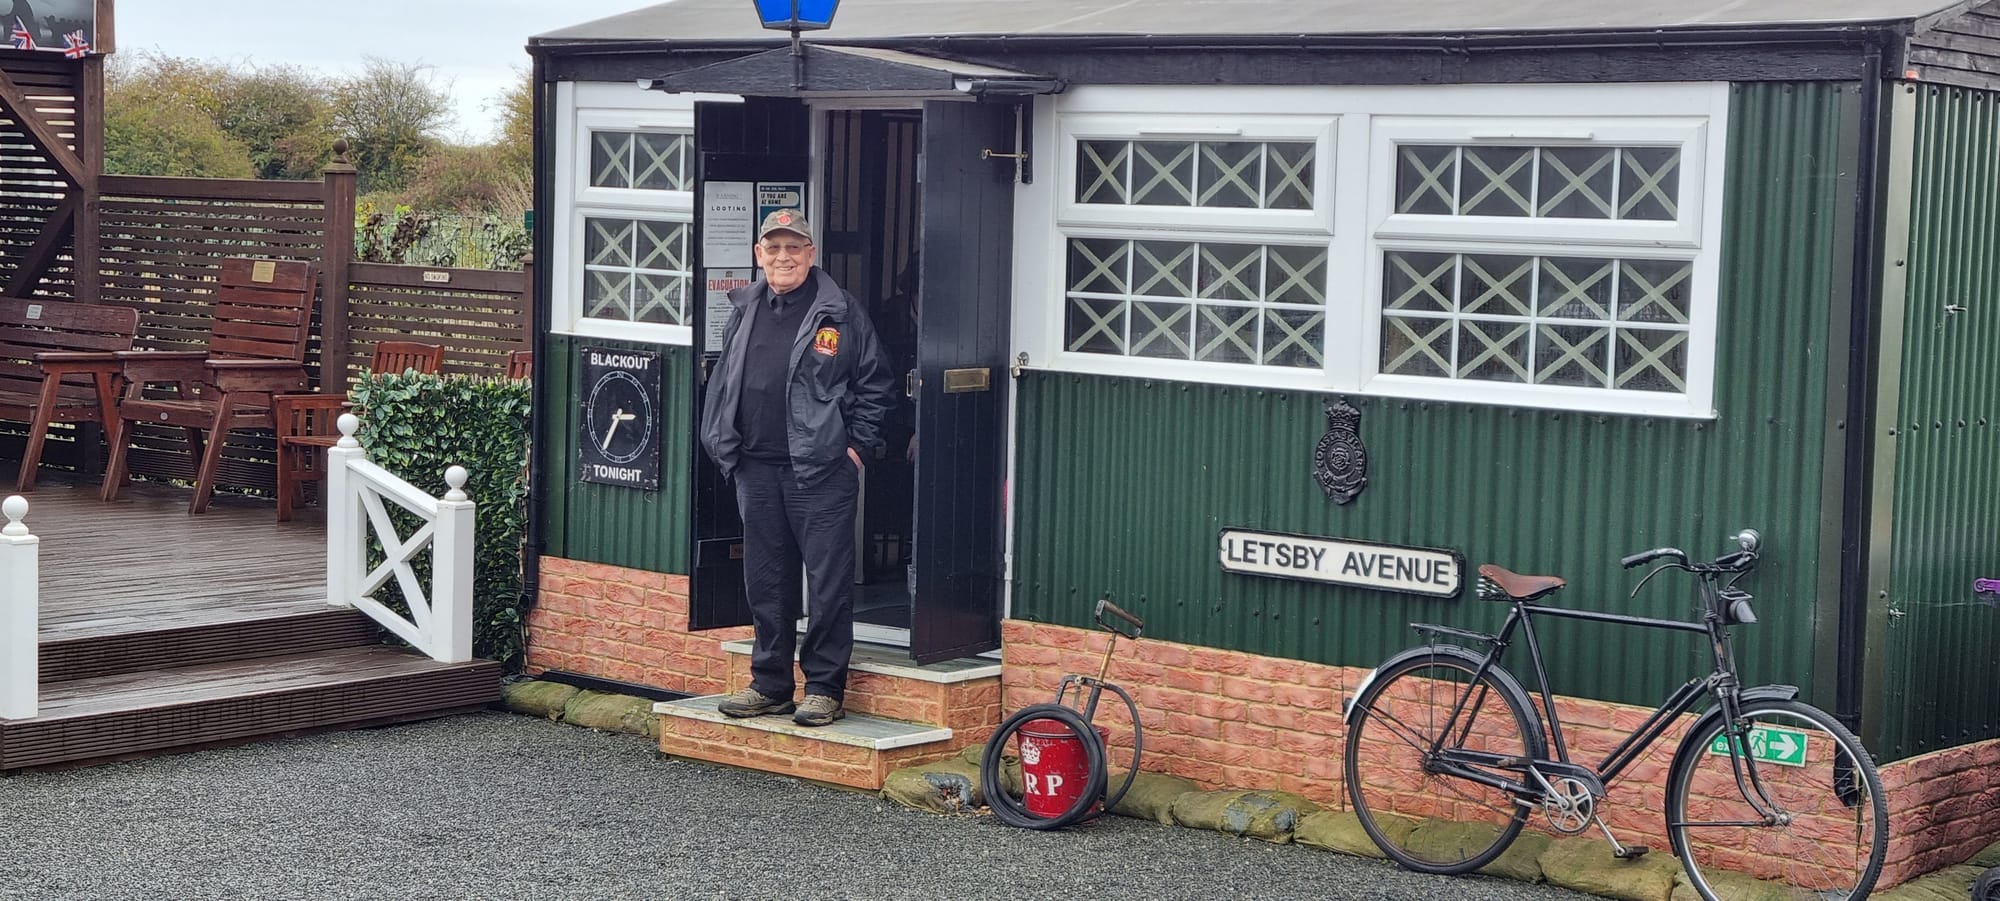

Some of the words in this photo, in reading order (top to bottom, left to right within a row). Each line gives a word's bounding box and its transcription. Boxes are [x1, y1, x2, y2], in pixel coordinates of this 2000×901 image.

[590, 352, 650, 370] BLACKOUT
[592, 464, 642, 482] TONIGHT
[1228, 538, 1327, 572] LETSBY
[1341, 551, 1451, 586] AVENUE
[1045, 774, 1064, 797] P
